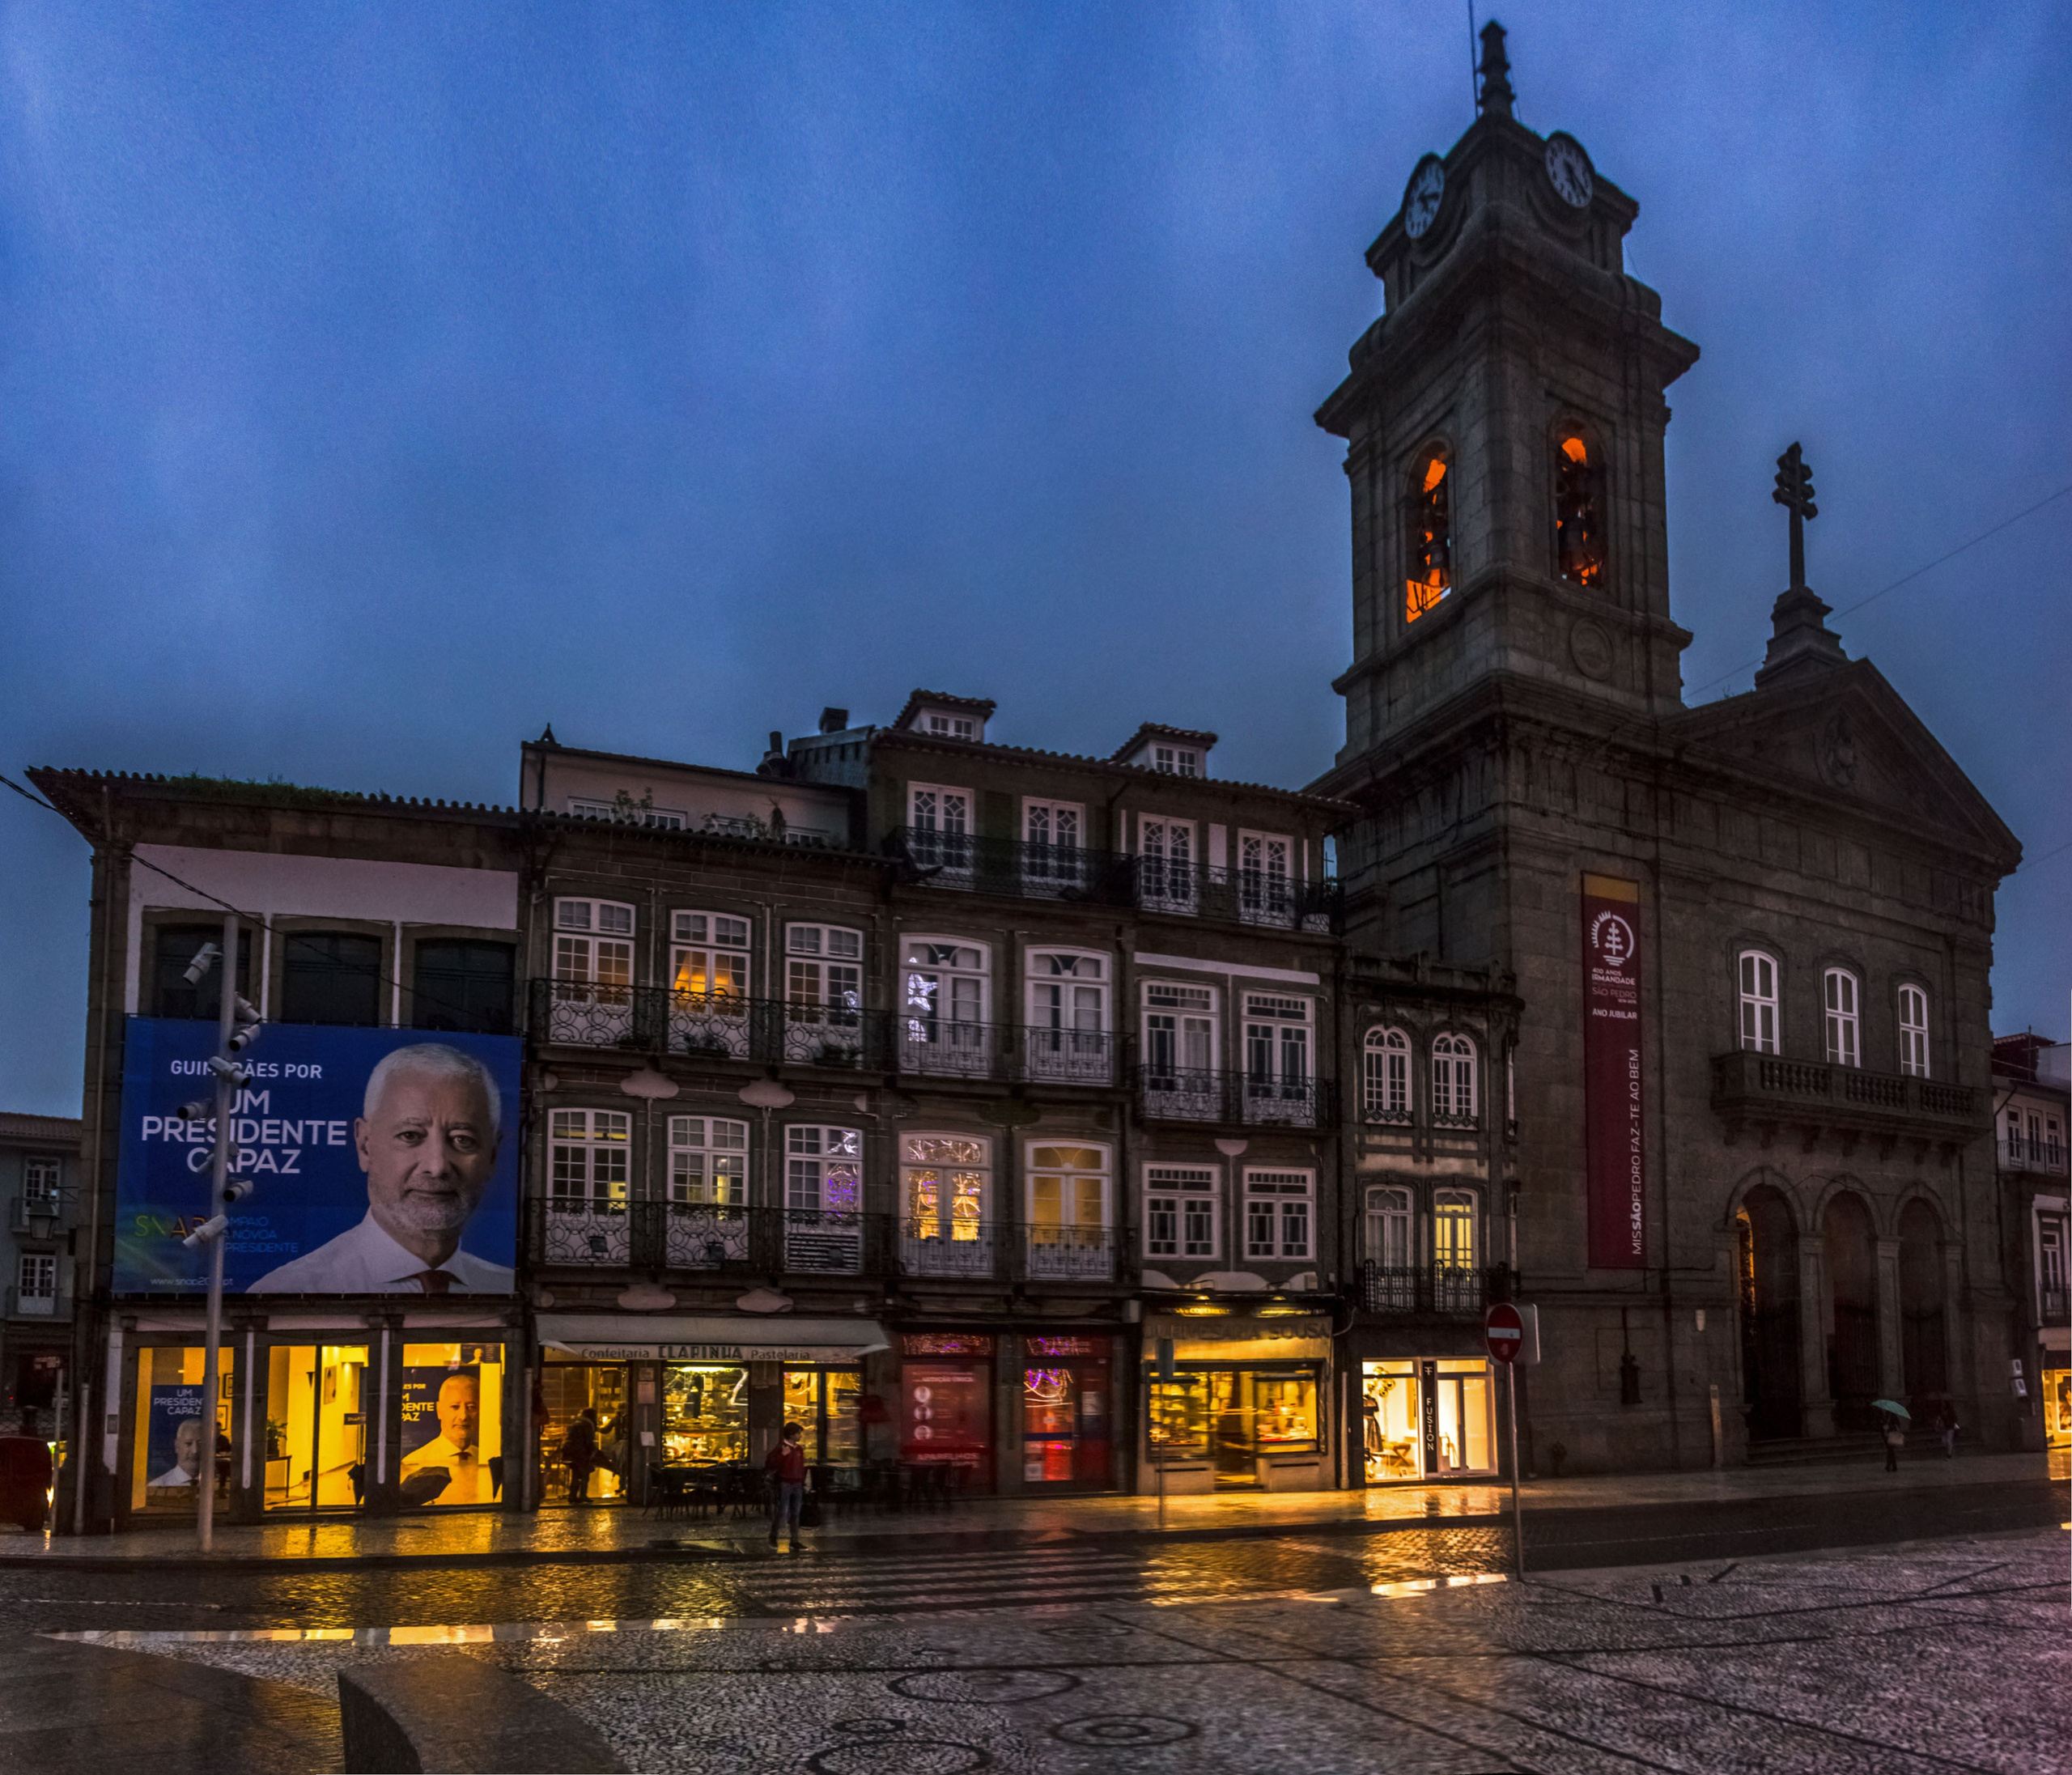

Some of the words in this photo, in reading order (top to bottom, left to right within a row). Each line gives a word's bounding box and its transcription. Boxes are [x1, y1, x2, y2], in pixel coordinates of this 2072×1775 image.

[1591, 974, 1636, 986] IRMANDADE
[1610, 989, 1637, 1000] PEDRO
[1592, 1008, 1608, 1017] ANO
[1608, 1009, 1638, 1020] JUBILAR
[171, 1059, 279, 1077] GUIÃES
[284, 1063, 323, 1079] POR
[1628, 1049, 1640, 1080] BEM
[1628, 1081, 1641, 1101] AO
[1629, 1103, 1641, 1153] FAZ-TE
[186, 1147, 301, 1175] CPAZ
[582, 1347, 650, 1359] Confeitaria
[751, 1348, 810, 1360] Pastelaria
[176, 1389, 193, 1398] UM
[167, 1406, 202, 1416] CAPAZ
[1425, 1397, 1435, 1451] FUSION
